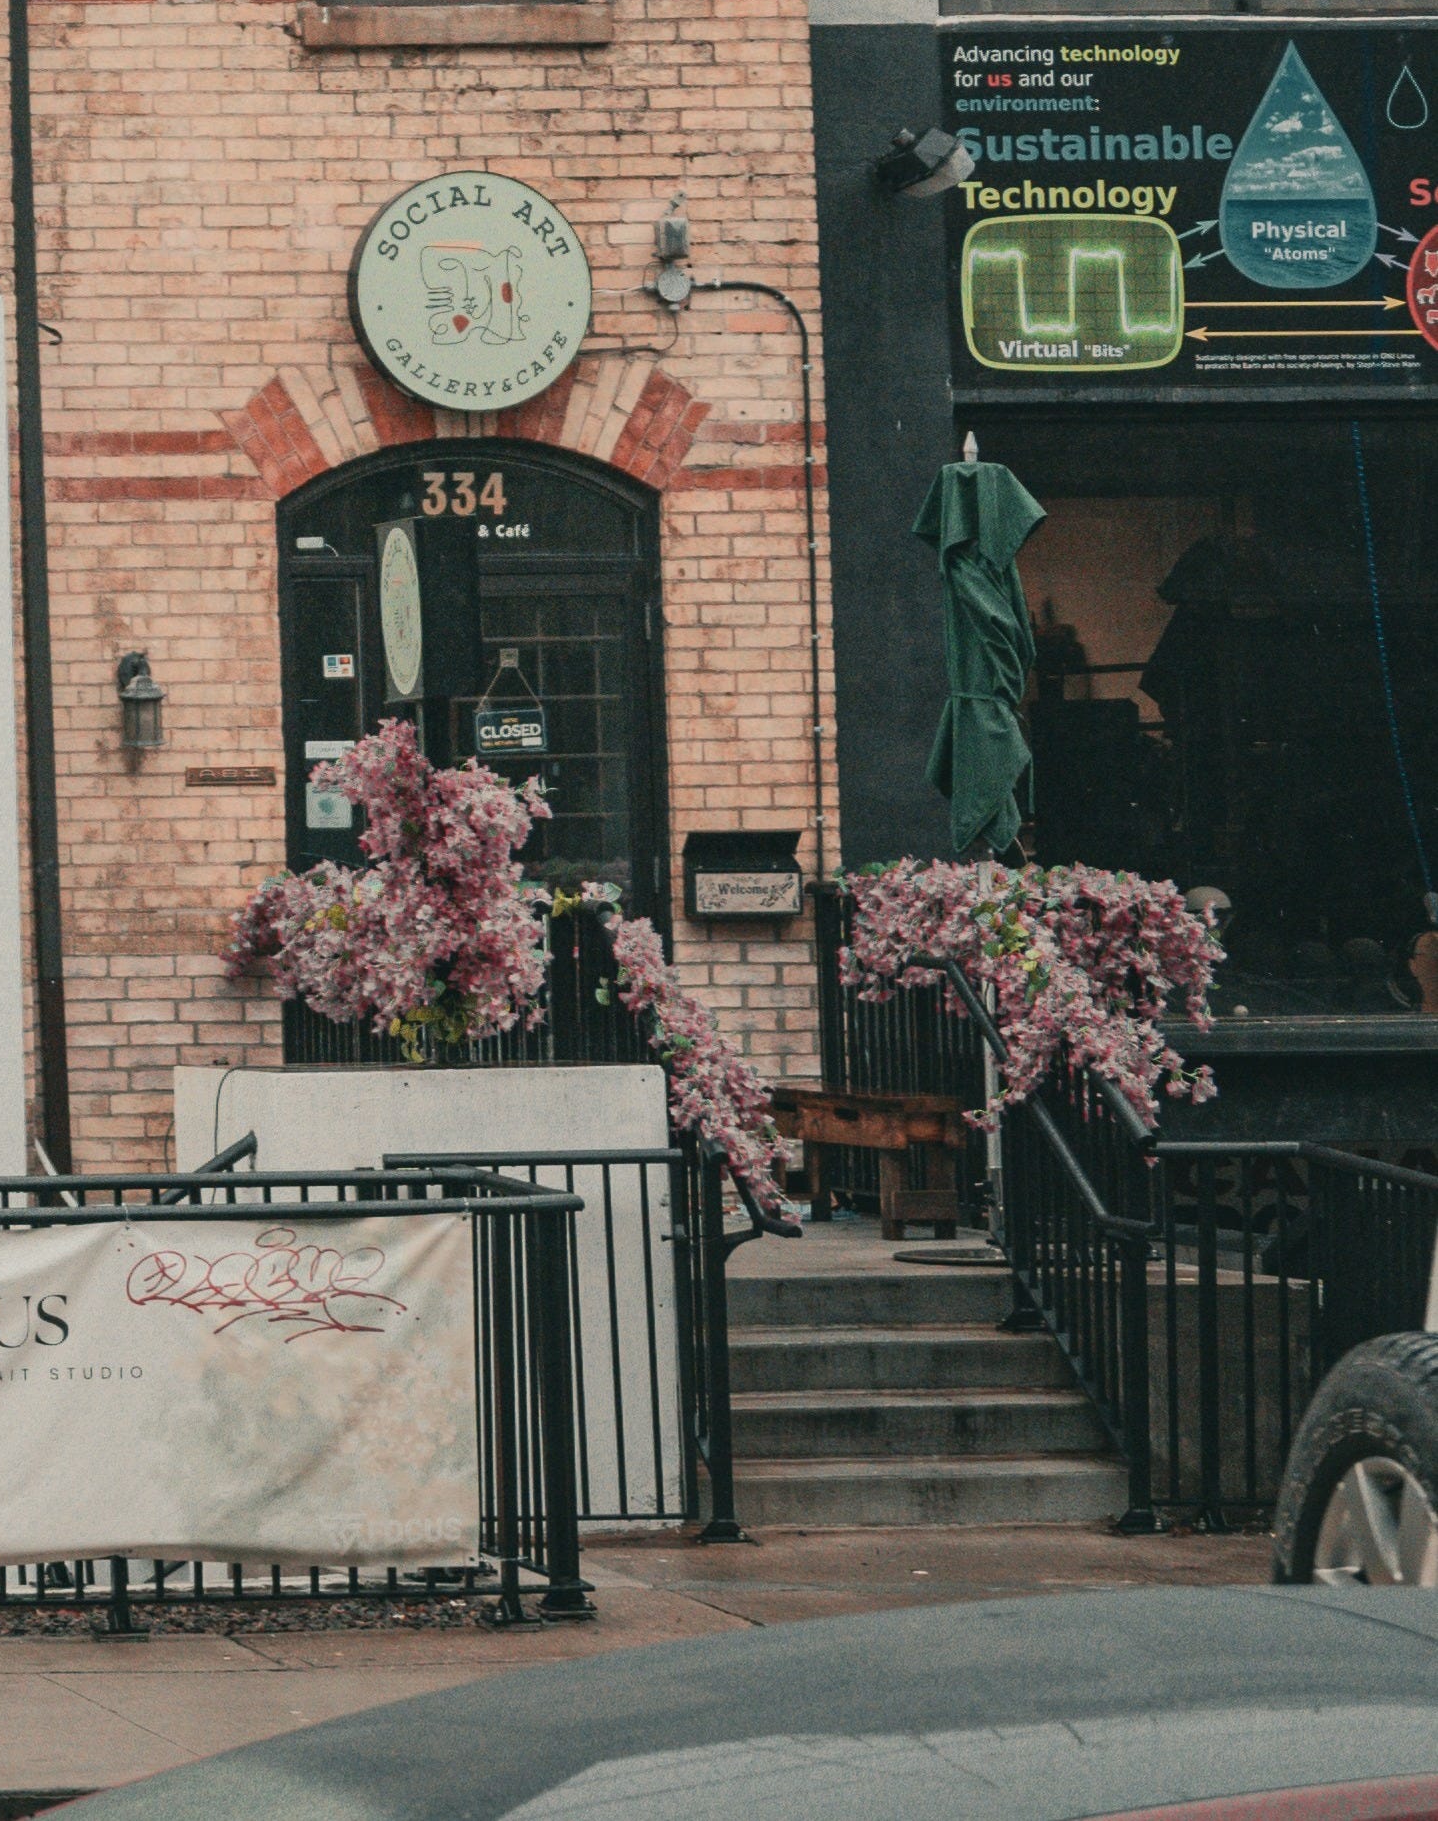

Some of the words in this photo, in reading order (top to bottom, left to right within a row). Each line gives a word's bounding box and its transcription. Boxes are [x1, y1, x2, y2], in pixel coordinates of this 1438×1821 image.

[953, 45, 1054, 65] Advancing
[1060, 44, 1181, 65] technology
[954, 69, 982, 87] for
[987, 73, 1012, 87] us
[1018, 69, 1055, 87] and
[1060, 72, 1093, 87] our
[955, 93, 1100, 112] environment:
[956, 124, 1234, 162] Sustainable
[958, 179, 1178, 216] Technology
[377, 184, 492, 262] SOCIAL
[512, 199, 571, 258] ART
[1251, 220, 1348, 242] Physical
[1263, 246, 1337, 261] "Atoms"
[998, 339, 1079, 359] Virtual
[1084, 342, 1130, 358] "Bits"
[421, 471, 508, 516] 334
[477, 525, 489, 538] &
[495, 523, 531, 538] Café
[480, 723, 542, 739] CLOSED
[718, 883, 769, 895] Welcome
[49, 1366, 145, 1380] STUDIO
